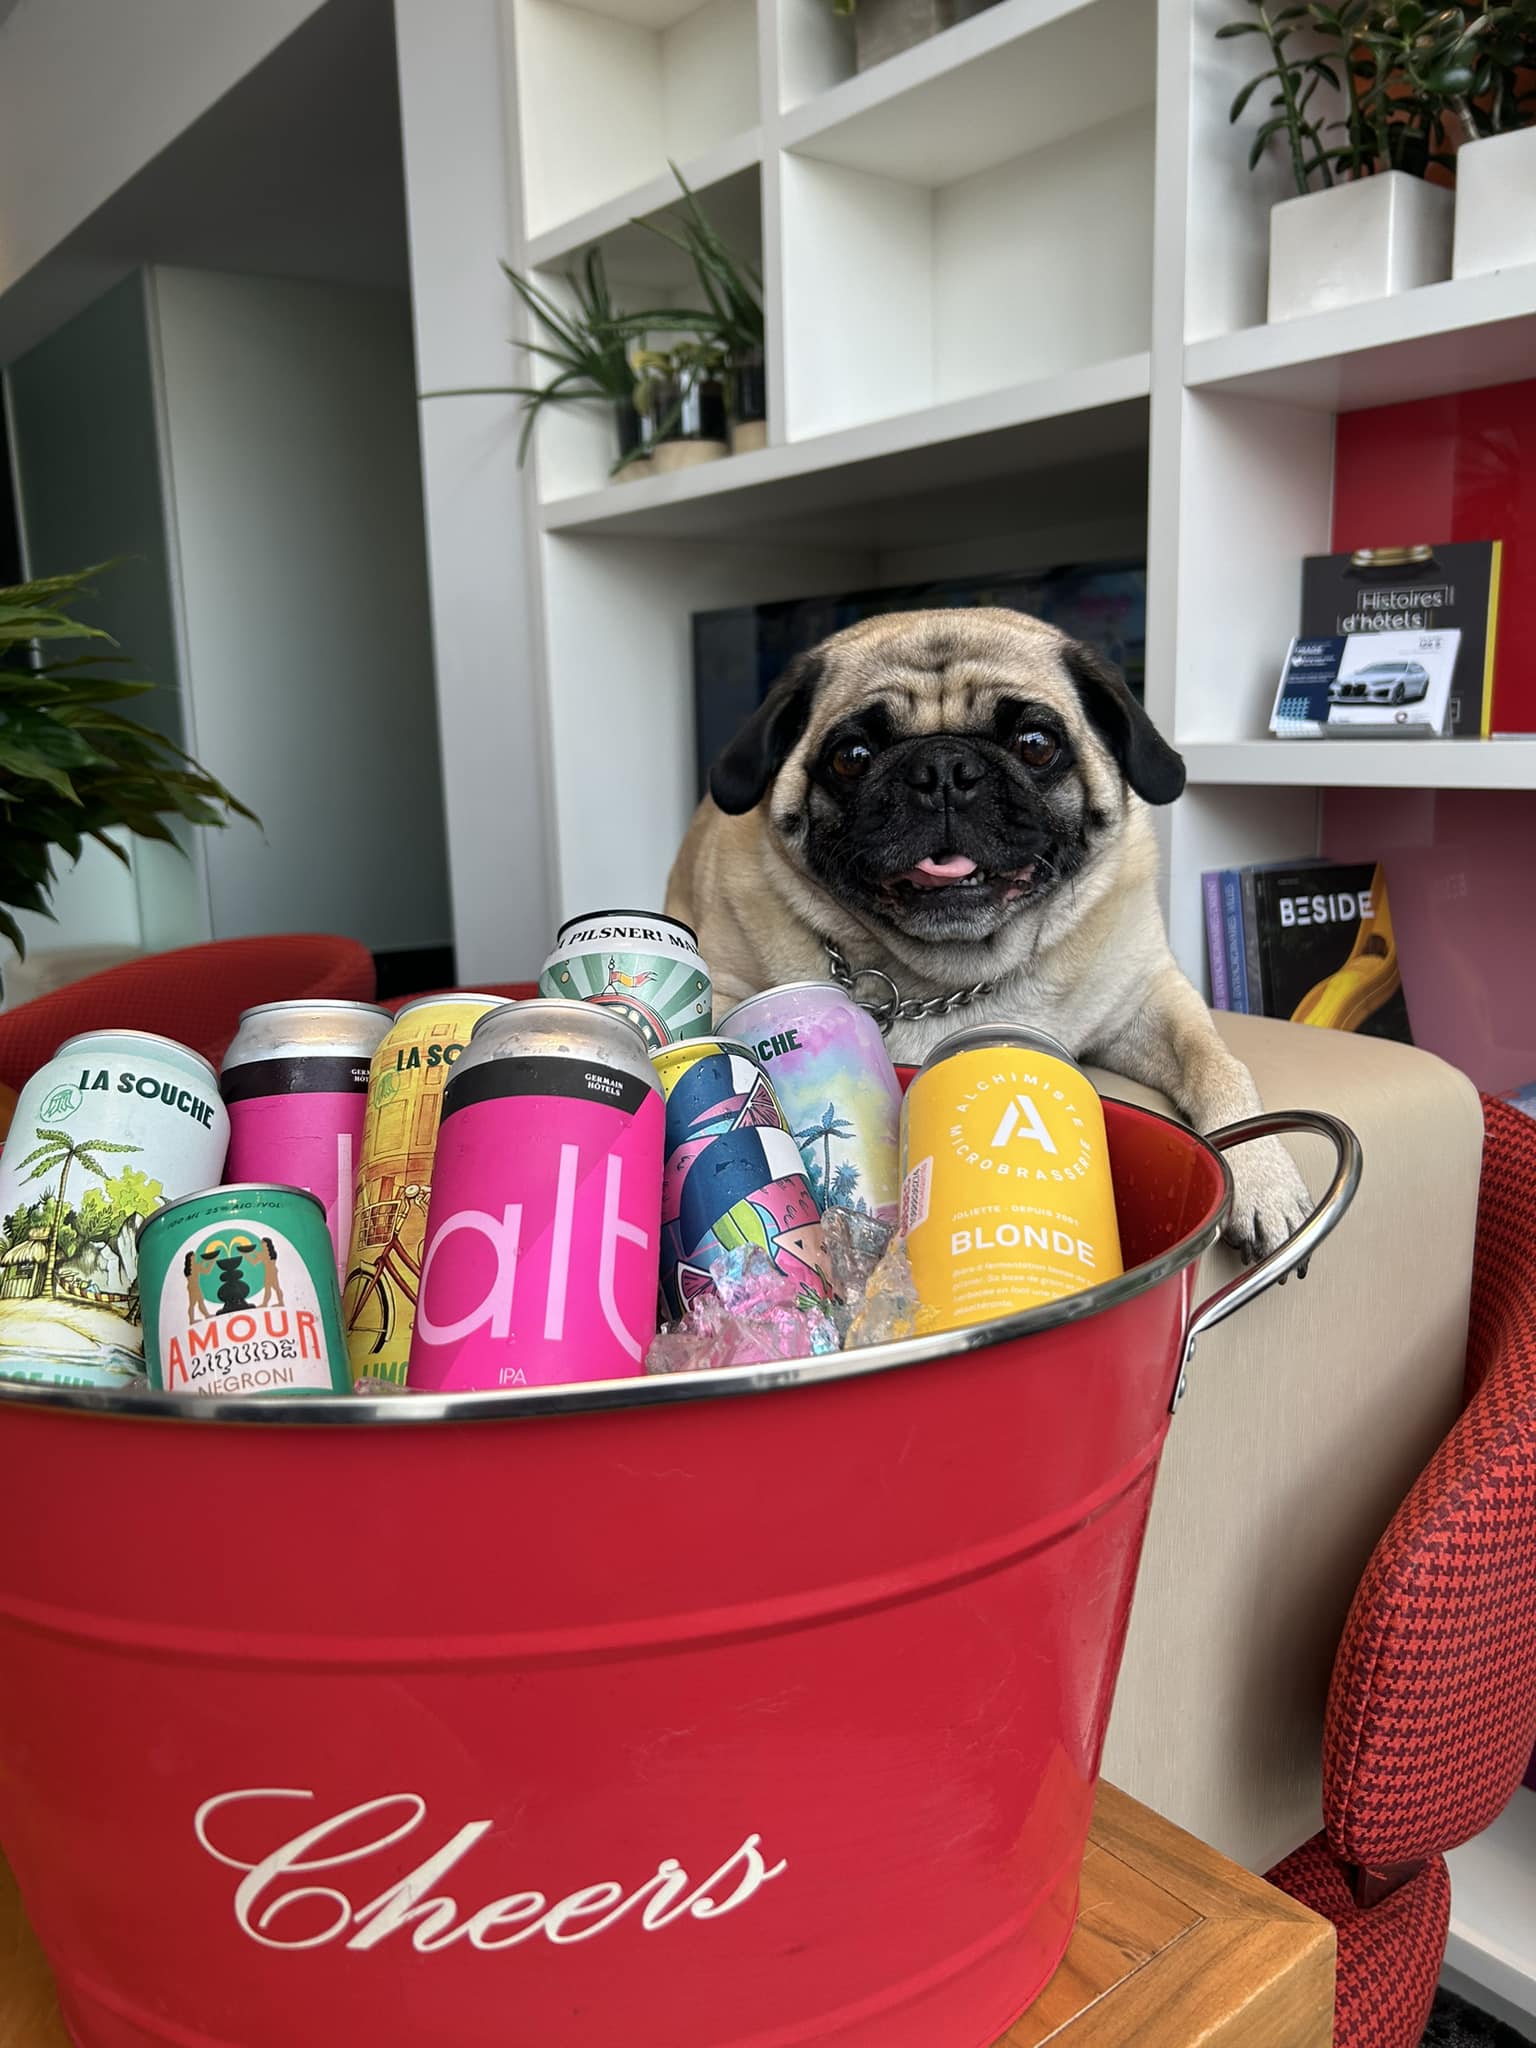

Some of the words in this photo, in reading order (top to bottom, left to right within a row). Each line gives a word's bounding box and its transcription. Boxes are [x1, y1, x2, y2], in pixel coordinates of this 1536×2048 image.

[1361, 590, 1442, 609] Histoires
[1279, 890, 1375, 927] BESIDE
[568, 927, 663, 945] PILSNER!
[396, 1046, 420, 1071] LA
[427, 1043, 465, 1067] SO
[584, 1073, 623, 1089] GERMAIN
[79, 1070, 109, 1090] LA
[117, 1073, 215, 1130] SOUCHE
[957, 1072, 1084, 1128] ALCHIMISTE
[949, 1124, 1092, 1182] MICROBRASSERIE
[951, 1204, 1001, 1221] JOLIETTE
[1011, 1204, 1053, 1217] DEPUIS
[417, 1143, 648, 1362] alt
[951, 1223, 1096, 1268] BLONDE
[168, 1310, 321, 1392] AMOUR
[199, 1367, 294, 1397] NEGRONI
[499, 1367, 528, 1384] IPA
[194, 1787, 788, 1952] Cheers
